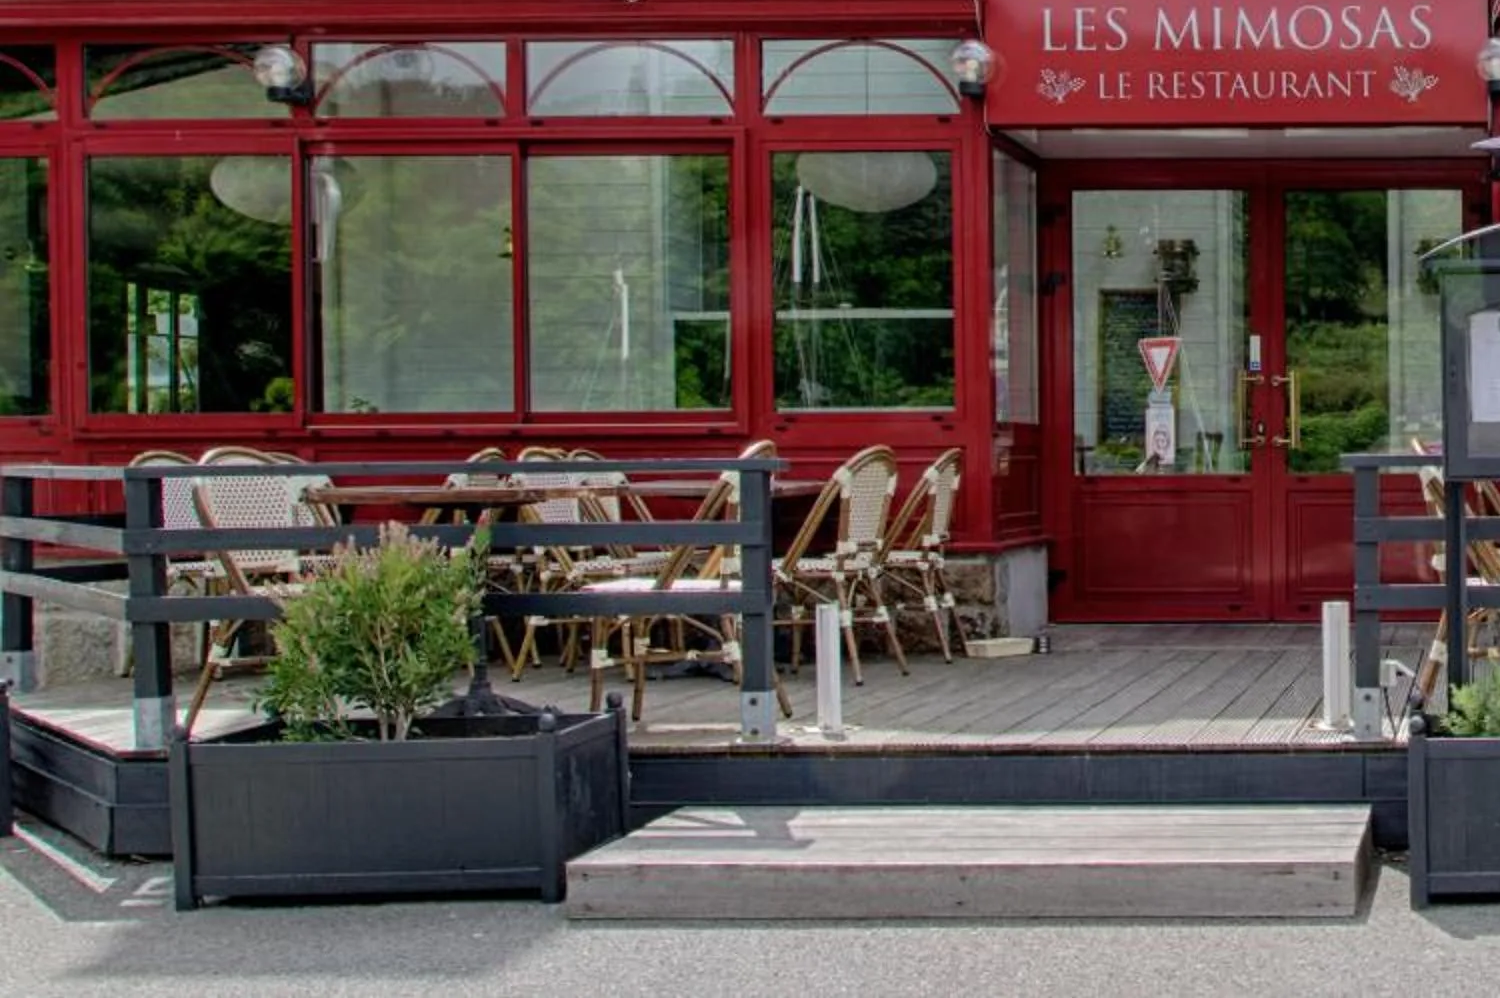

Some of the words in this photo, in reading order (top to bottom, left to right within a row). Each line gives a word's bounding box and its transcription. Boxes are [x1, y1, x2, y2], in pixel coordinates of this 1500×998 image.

[1042, 7, 1129, 52] LES
[1154, 4, 1433, 51] MIMOSAS
[1099, 72, 1132, 100] LE
[1148, 70, 1377, 100] RESTAURANT
